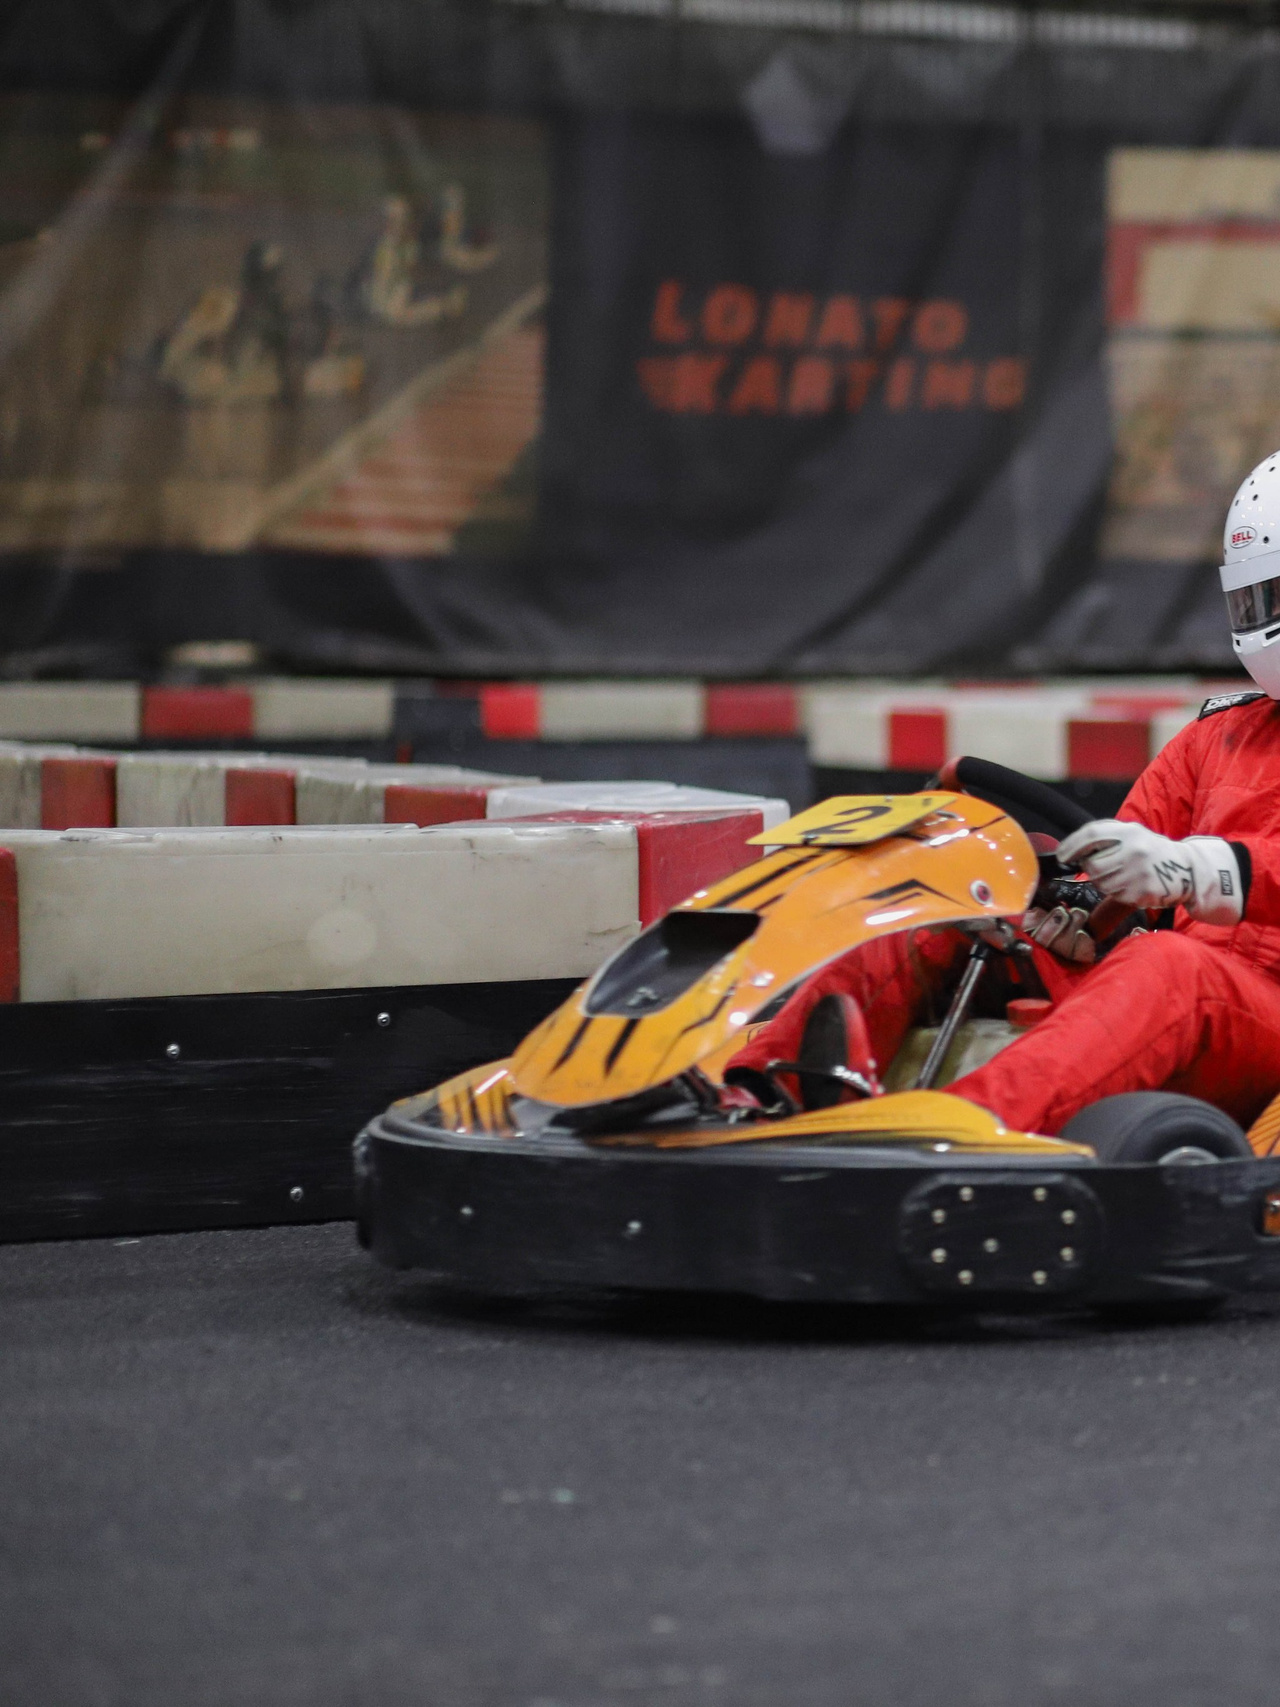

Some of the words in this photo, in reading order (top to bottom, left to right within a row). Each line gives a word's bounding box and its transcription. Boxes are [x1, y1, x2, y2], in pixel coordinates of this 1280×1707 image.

[650, 277, 970, 352] LONATO
[636, 352, 1028, 415] KARTING
[1231, 531, 1253, 544] BELL
[798, 805, 893, 836] 2
